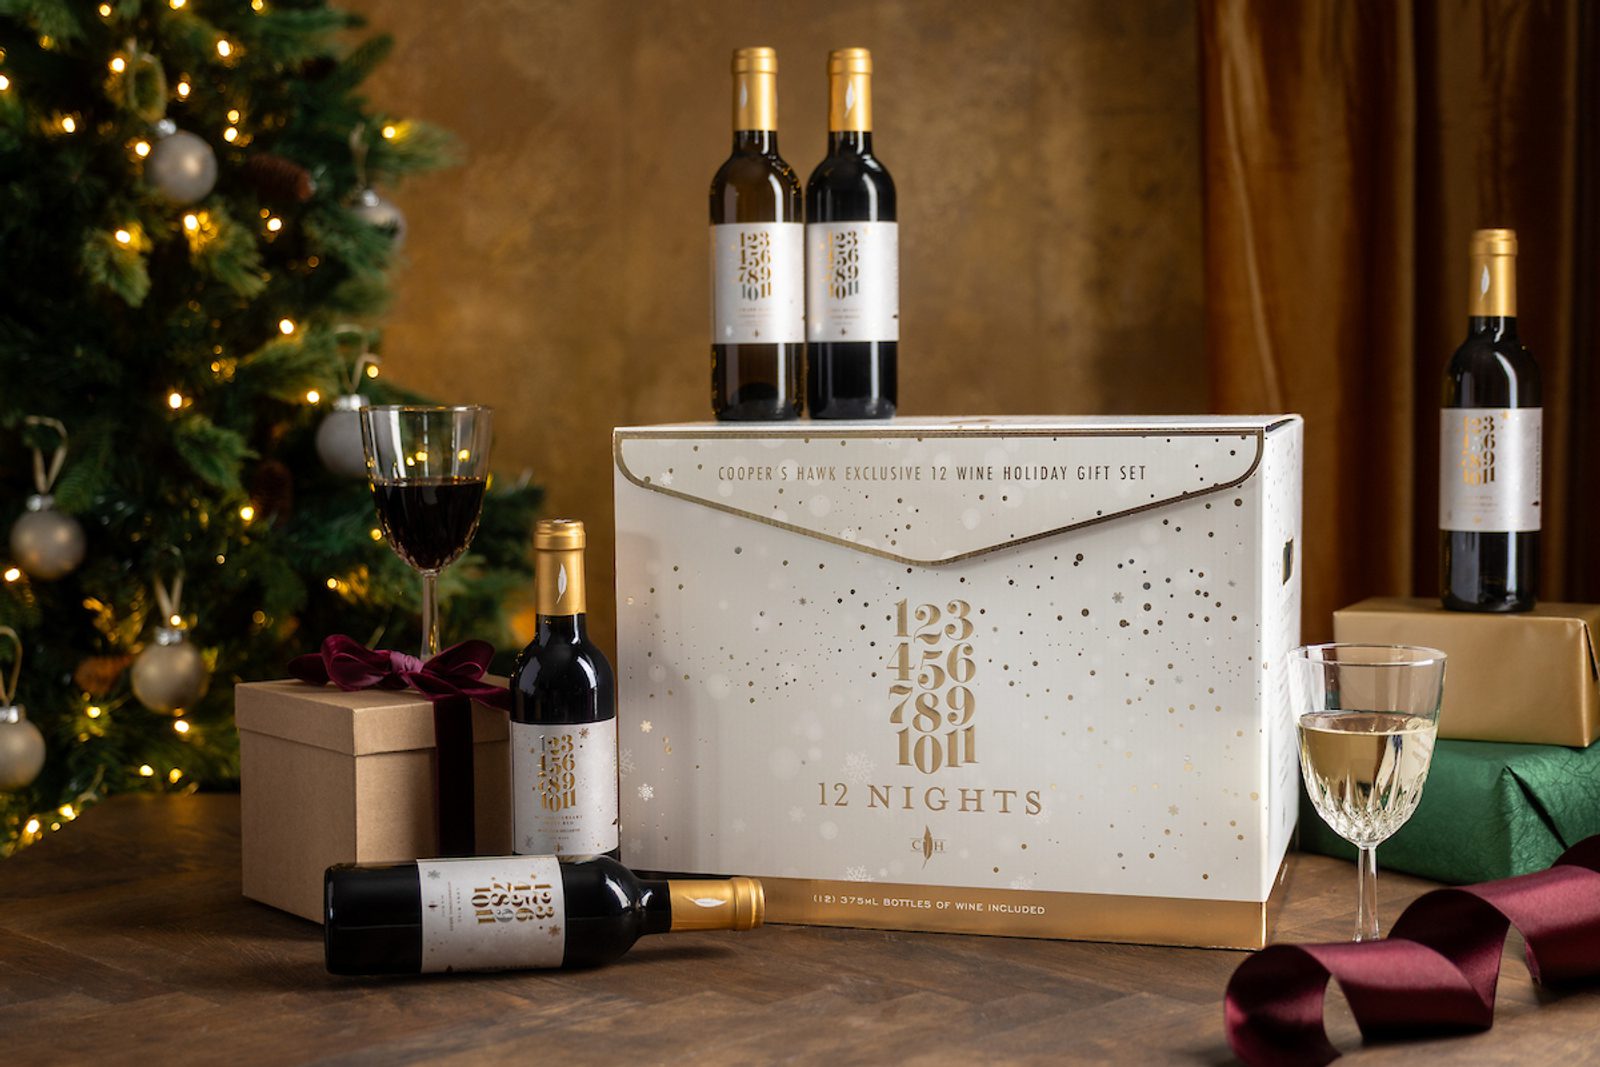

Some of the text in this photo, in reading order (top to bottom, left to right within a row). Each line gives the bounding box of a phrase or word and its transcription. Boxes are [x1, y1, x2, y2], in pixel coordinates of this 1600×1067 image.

[718, 466, 1146, 481] COOPER'S HAWK EXCLUSIVE 12 WINE HOLIDAY GIFT SET
[894, 597, 974, 645] 123
[886, 642, 976, 690] 456
[888, 684, 975, 733] 789
[818, 782, 1042, 816] 12 NIGHTS
[813, 893, 836, 904] (12)
[883, 898, 931, 909] BOTTLES
[936, 900, 951, 910] OF
[955, 901, 983, 912] WINE
[988, 903, 1045, 915] INCLUDED
